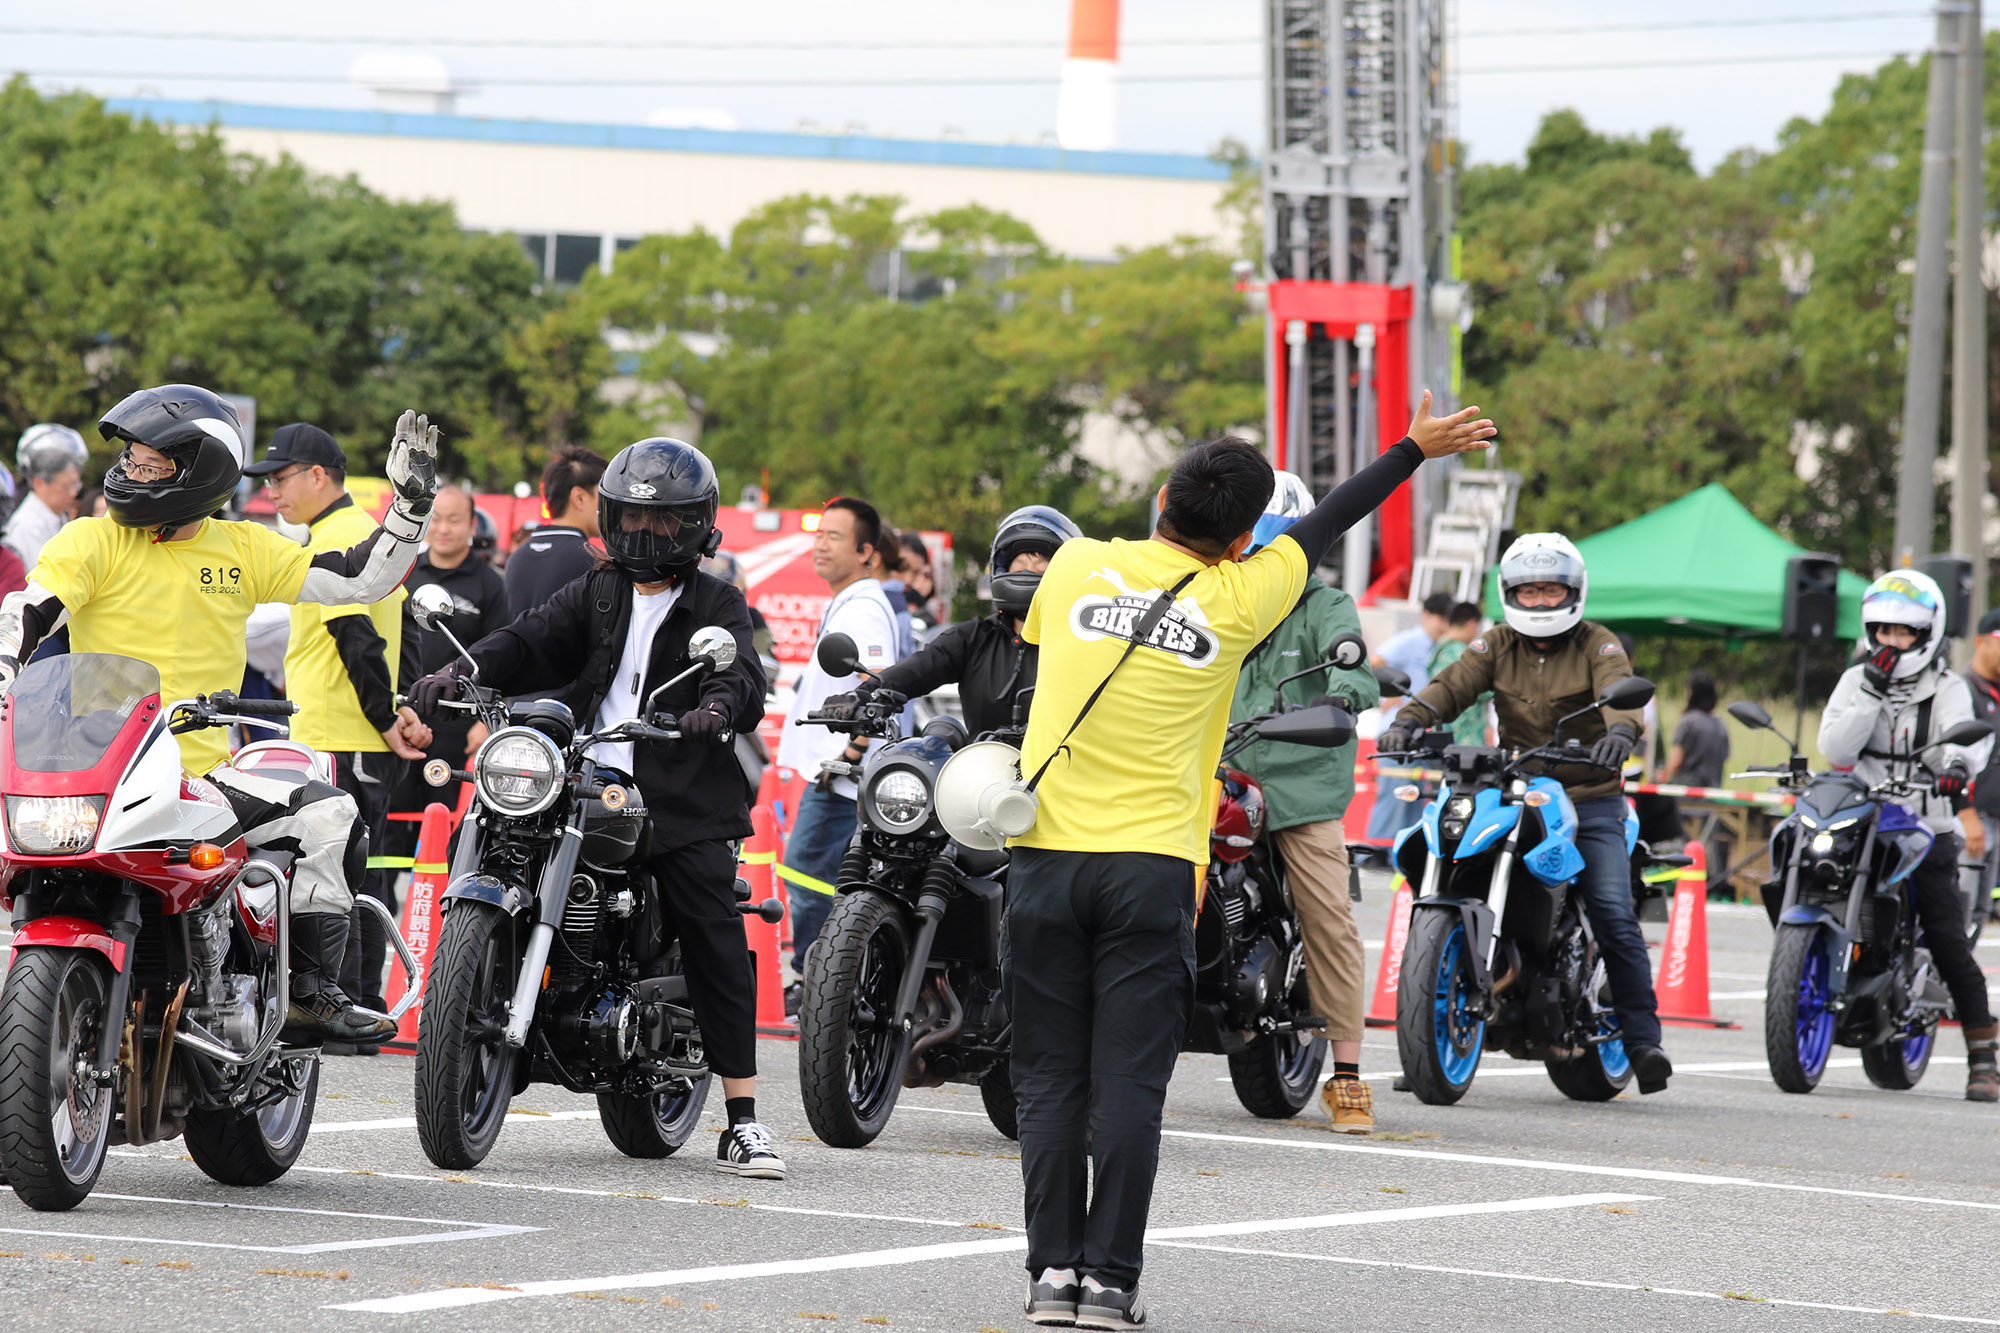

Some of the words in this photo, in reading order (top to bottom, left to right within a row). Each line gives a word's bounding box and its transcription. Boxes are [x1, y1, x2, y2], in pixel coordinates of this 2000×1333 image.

[200, 567, 241, 585] 819
[200, 586, 217, 594] FES
[218, 586, 241, 595] 2024
